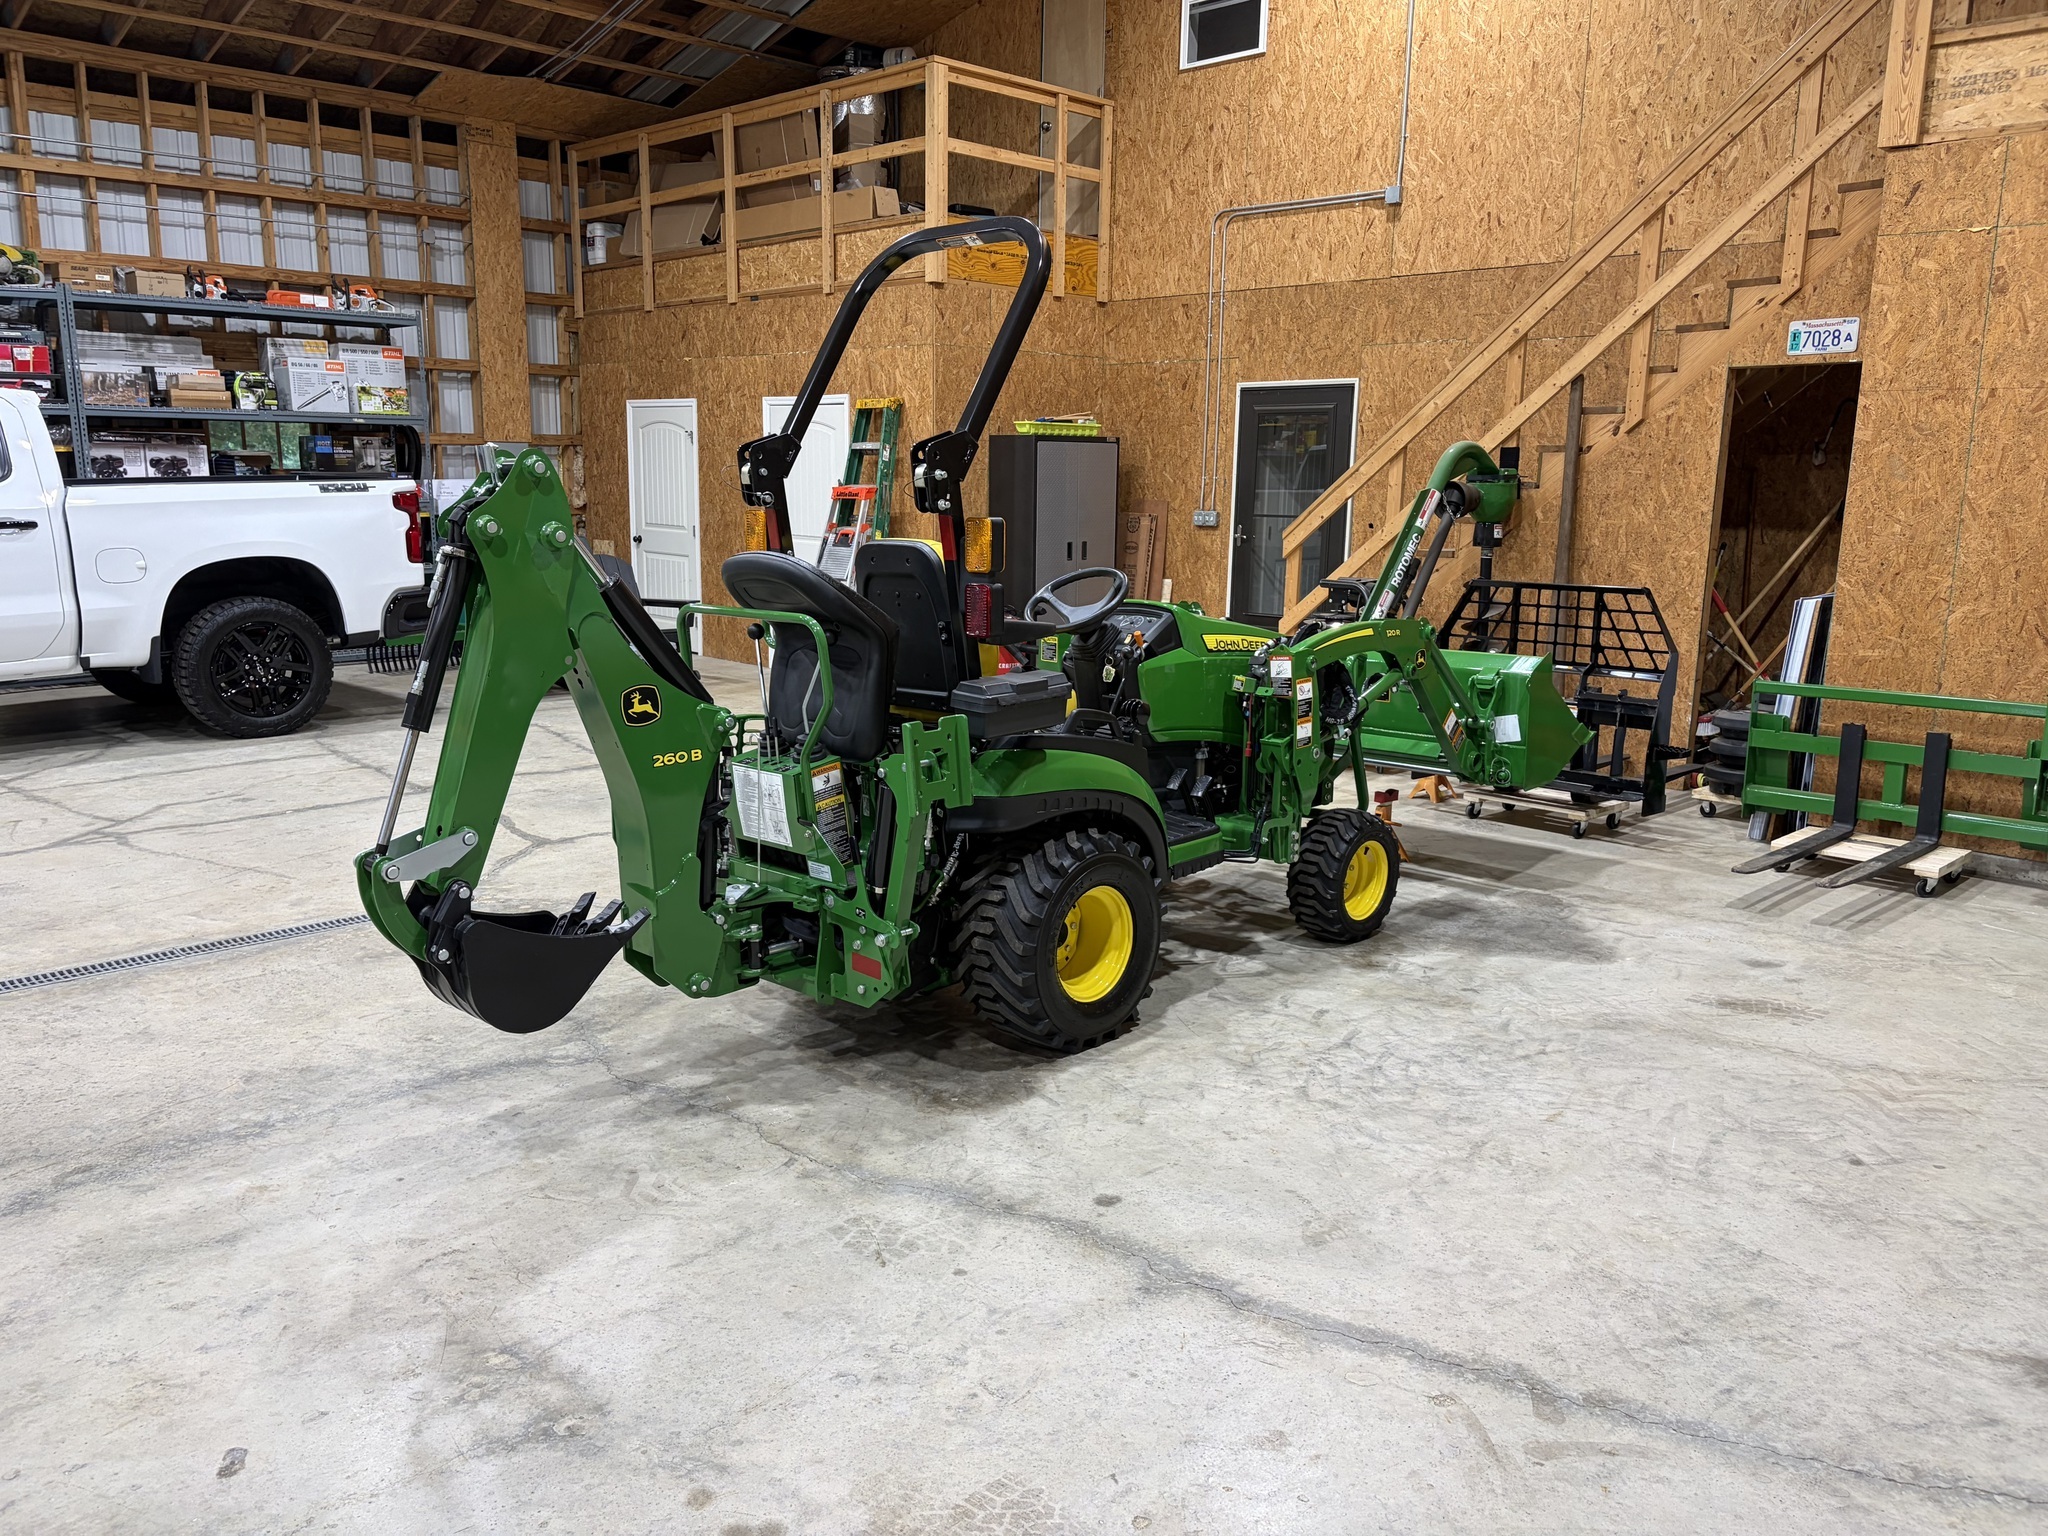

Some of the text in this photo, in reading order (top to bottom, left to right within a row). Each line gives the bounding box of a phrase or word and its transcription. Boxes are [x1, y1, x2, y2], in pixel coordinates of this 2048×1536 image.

[1805, 320, 1845, 329] Massachusetts
[1792, 332, 1799, 342] F
[1802, 329, 1853, 349] 7028 A
[1390, 533, 1422, 588] ROTOMEC
[1213, 638, 1240, 649] JOHN
[652, 748, 703, 768] 260 B
[816, 764, 838, 775] WARNING
[821, 797, 842, 808] CAUTION
